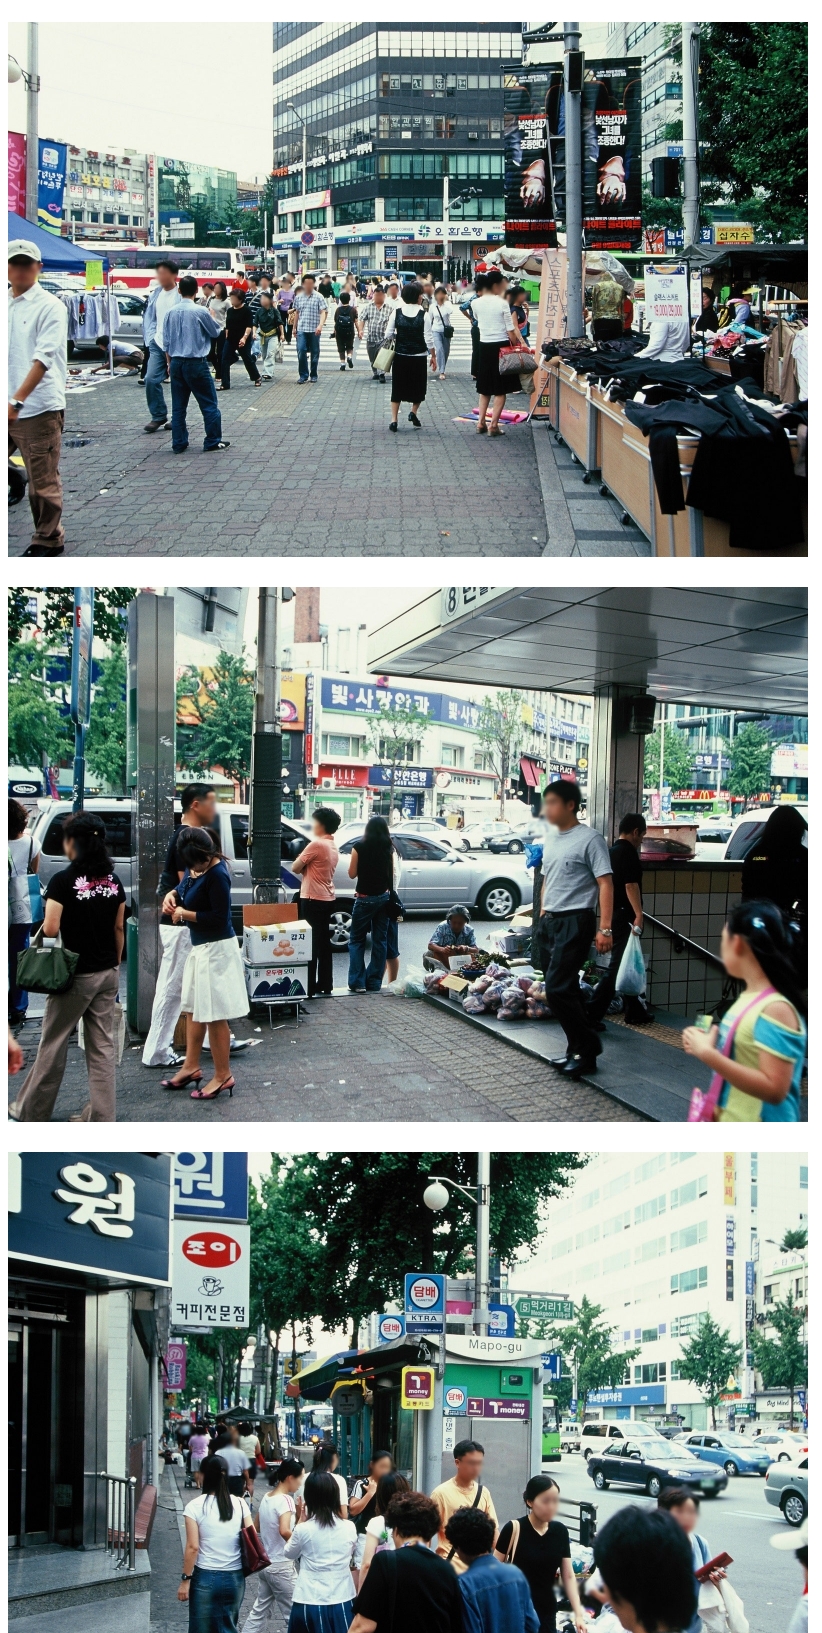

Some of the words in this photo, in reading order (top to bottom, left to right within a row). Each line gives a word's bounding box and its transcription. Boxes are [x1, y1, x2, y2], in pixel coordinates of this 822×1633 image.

[518, 119, 547, 131] 낯선남자가
[596, 115, 627, 126] 낯선남자가
[524, 130, 544, 140] 그녀를
[602, 126, 621, 136] 그녀를
[520, 139, 547, 150] 조종한다!
[597, 135, 626, 146] 조종한다!
[718, 232, 751, 242] 십자수
[445, 587, 458, 613] 8
[332, 768, 355, 781] ELLE
[393, 768, 428, 783] 신한은행
[186, 1240, 237, 1262] 조이
[414, 1286, 436, 1298] 담배
[530, 1300, 571, 1312] 먹거리1길
[176, 1303, 246, 1323] 커피전문점
[411, 1314, 438, 1322] KTRA
[383, 1323, 400, 1333] 담배
[469, 1339, 522, 1352] Mapo-gu
[448, 1392, 463, 1402] 담배
[500, 1406, 526, 1416] money
